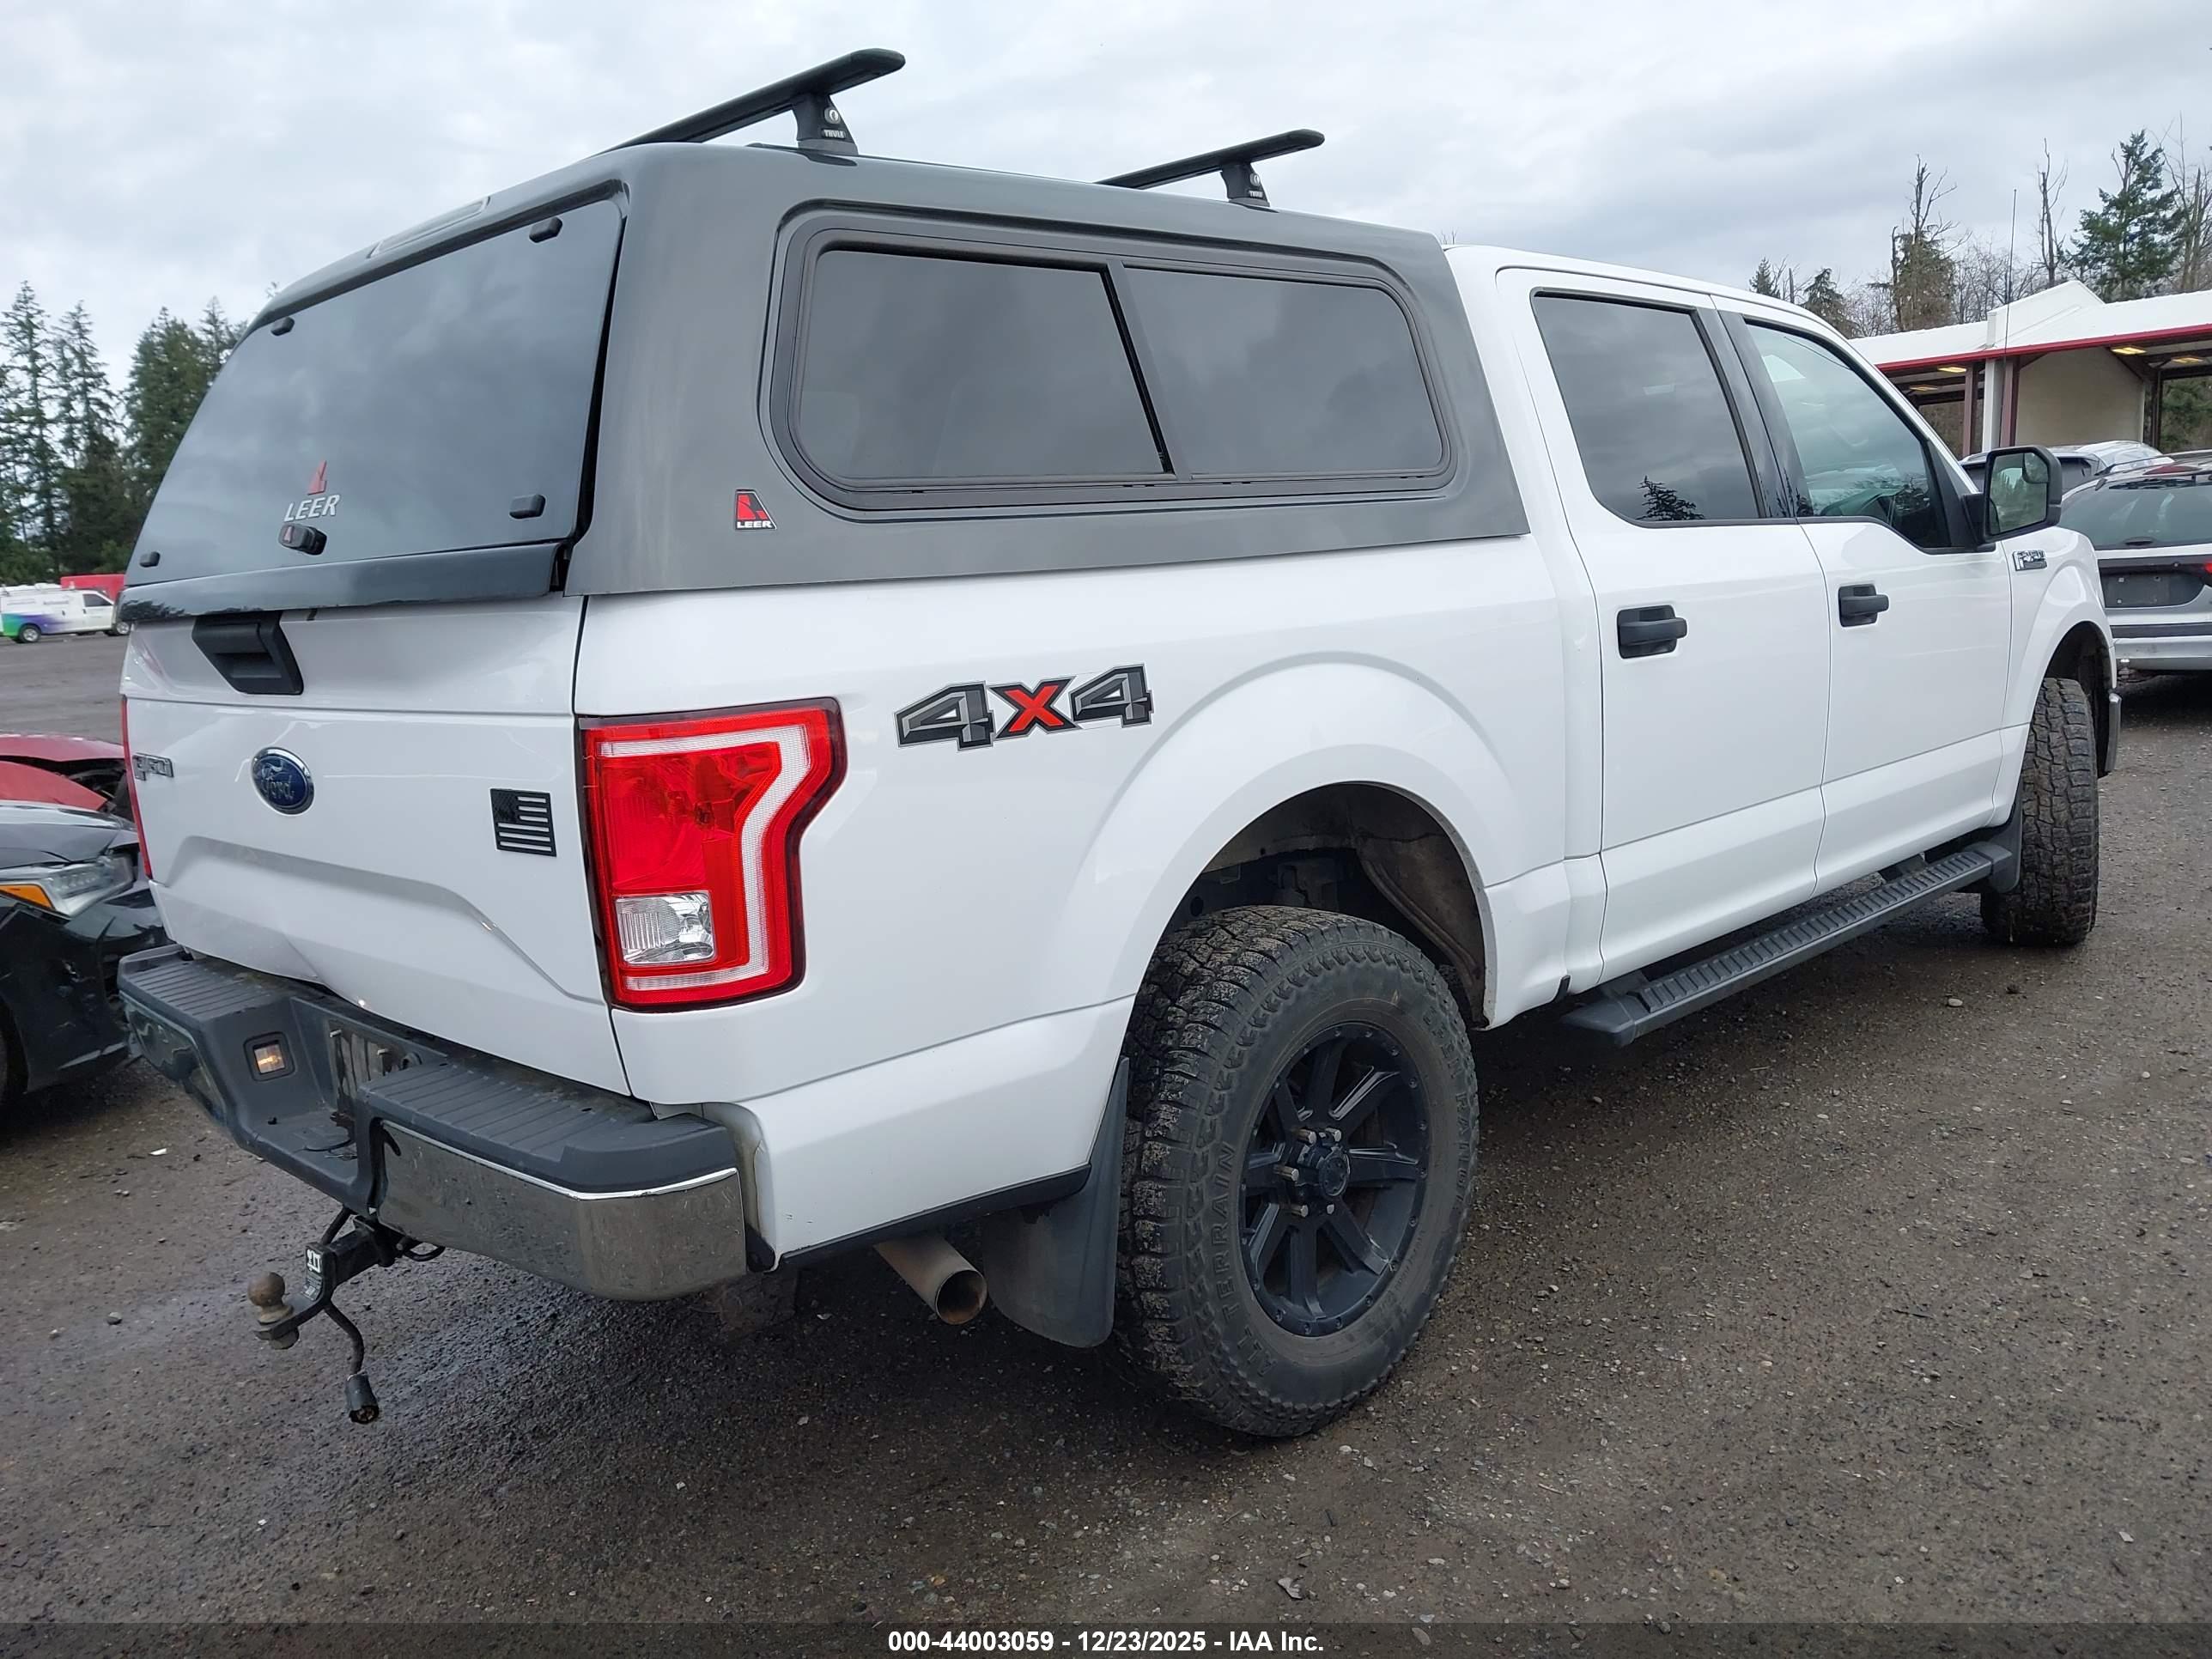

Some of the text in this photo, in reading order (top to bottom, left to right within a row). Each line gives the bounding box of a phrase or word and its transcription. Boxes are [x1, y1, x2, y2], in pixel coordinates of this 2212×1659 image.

[283, 494, 341, 522] LEER
[737, 520, 773, 529] LEER
[259, 759, 296, 801] Ford
[1211, 1139, 1279, 1377] ALL TERRAIN
